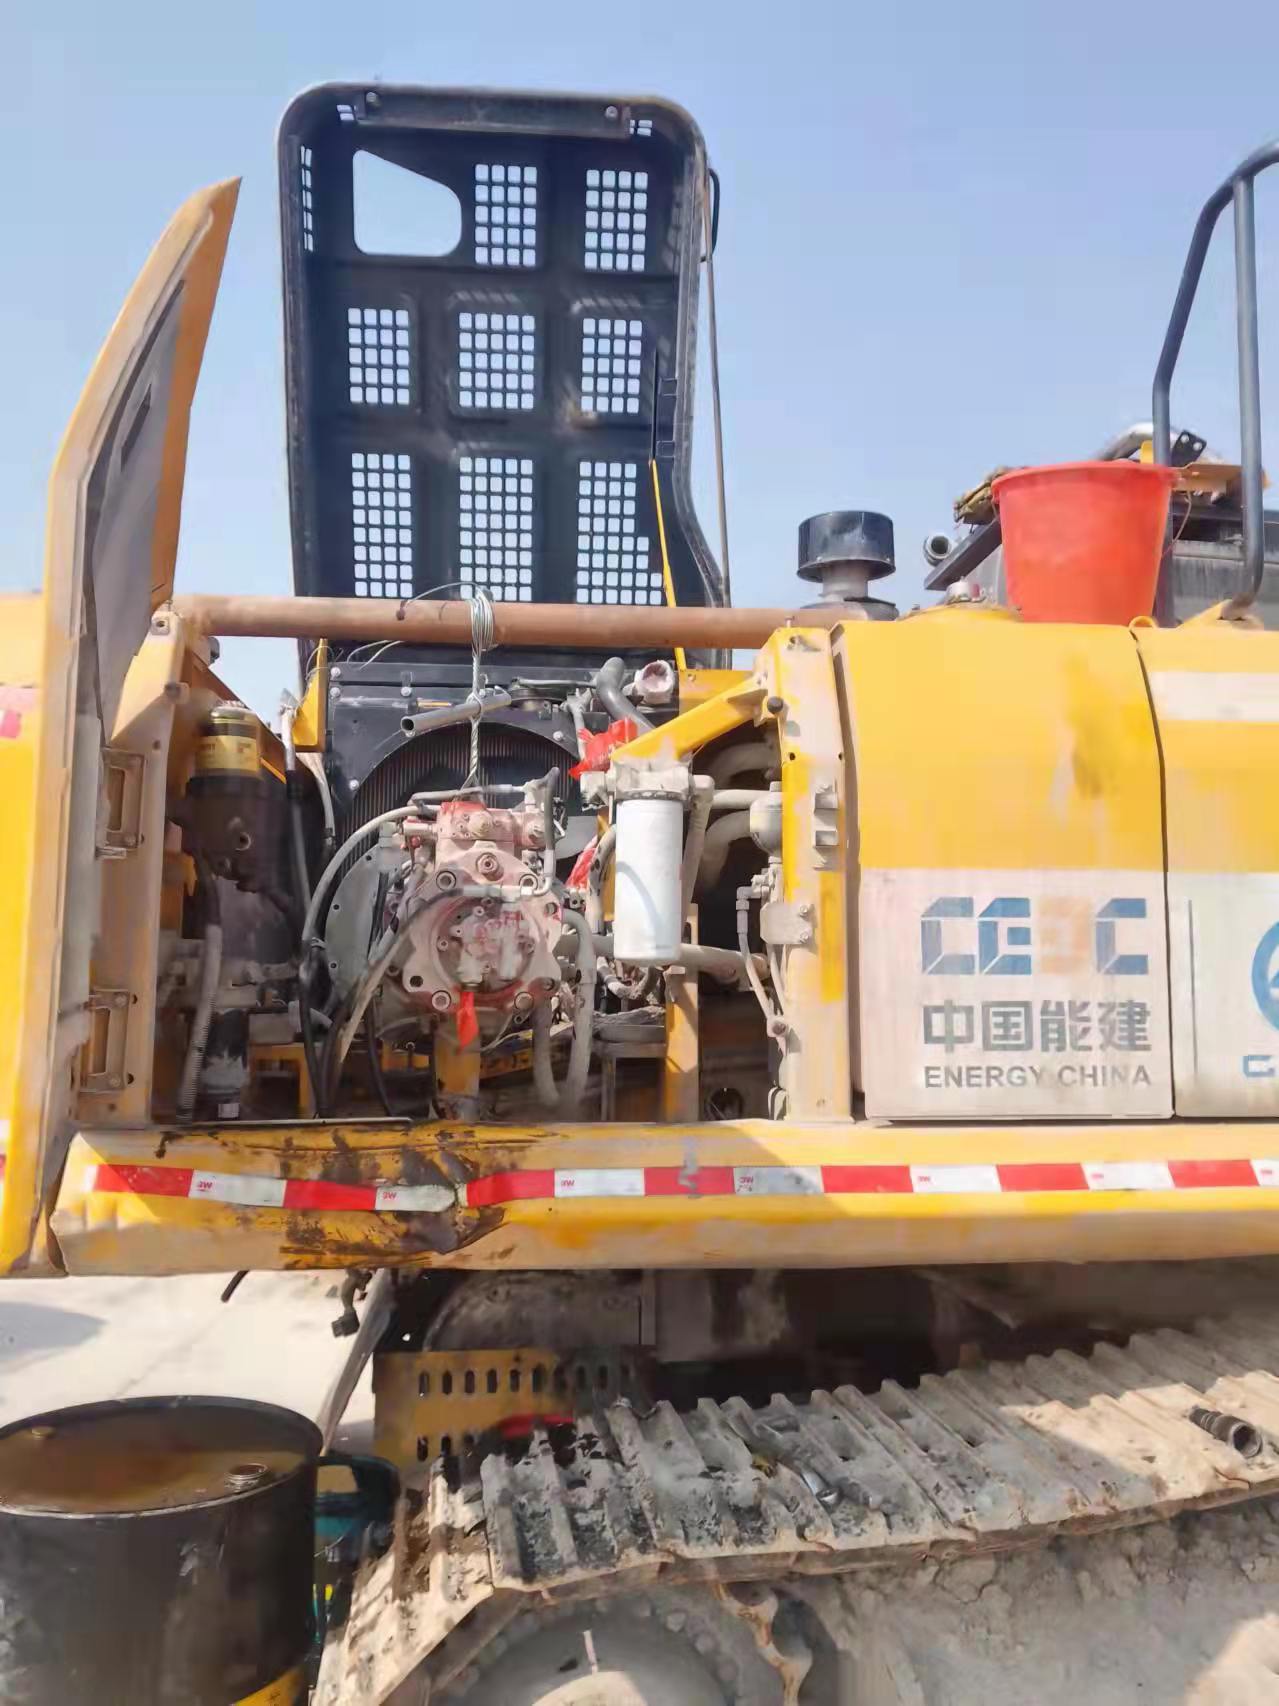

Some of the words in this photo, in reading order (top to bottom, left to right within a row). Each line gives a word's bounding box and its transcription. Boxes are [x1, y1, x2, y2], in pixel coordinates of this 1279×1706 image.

[923, 999, 1152, 1053] 中国能建
[924, 1065, 1043, 1088] ENERGY
[1057, 1064, 1151, 1087] CHINA
